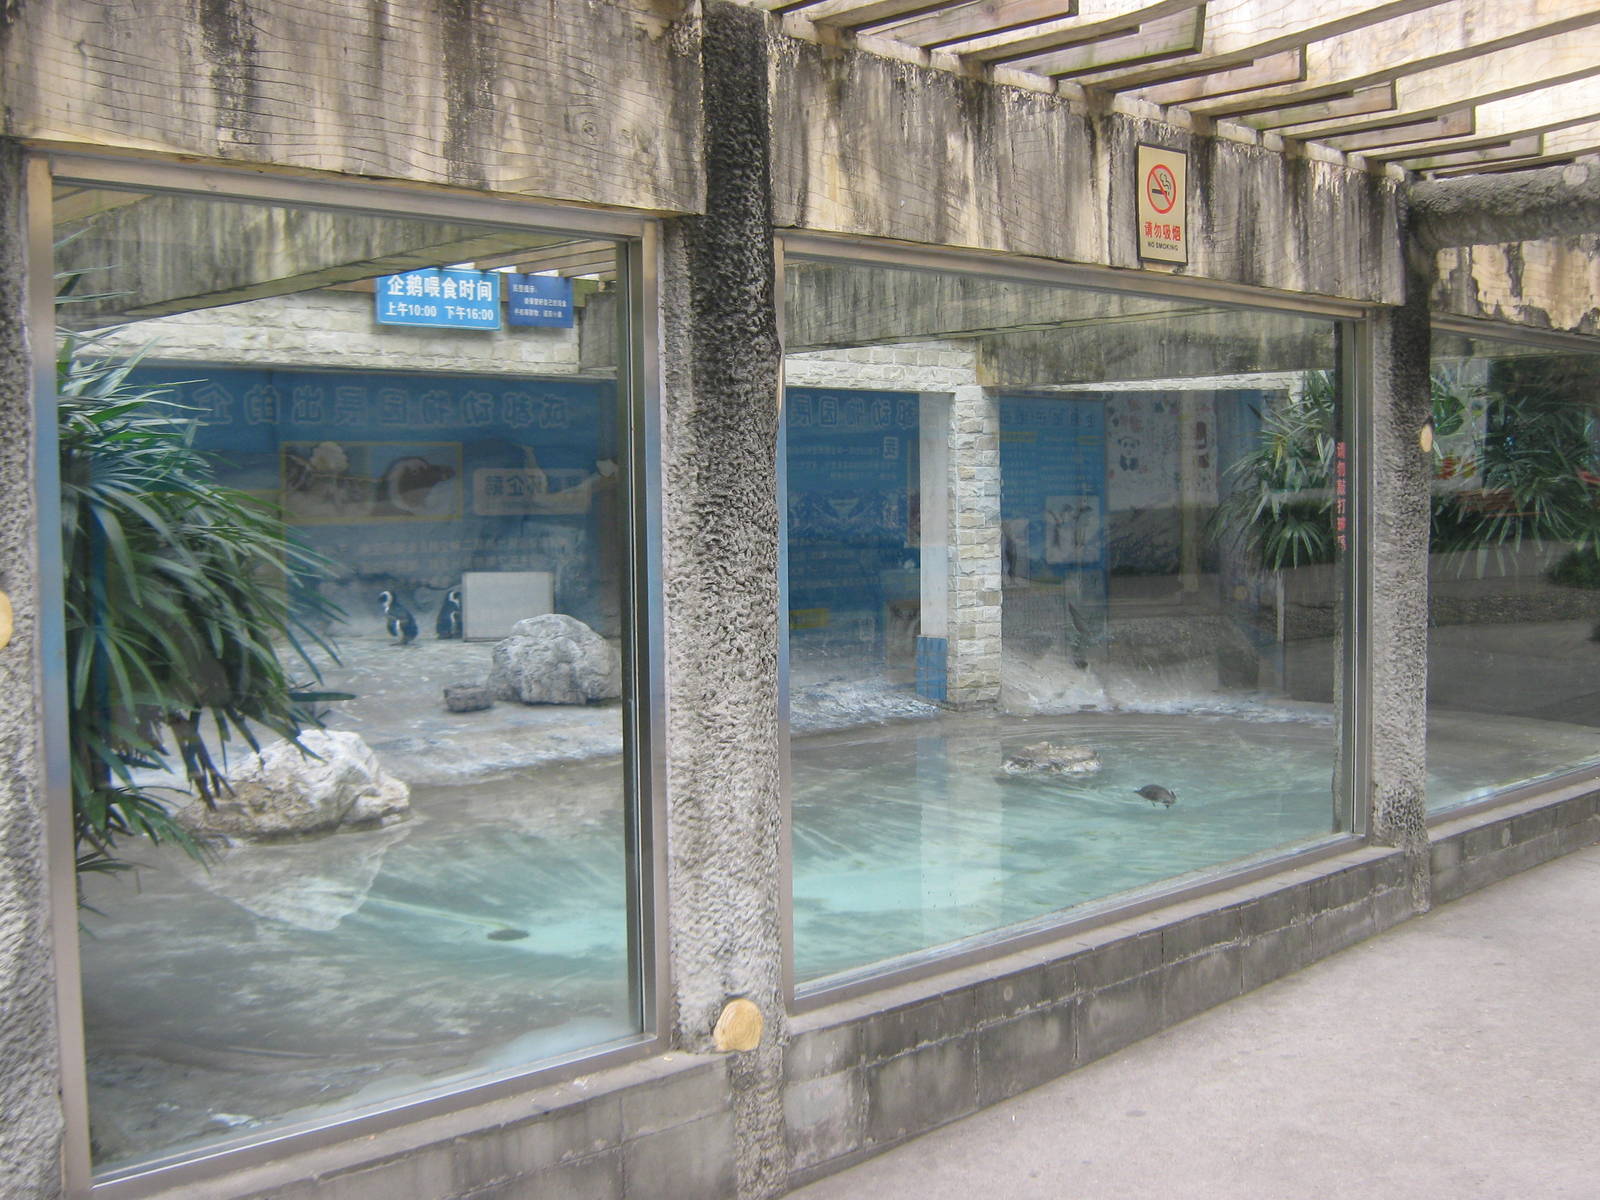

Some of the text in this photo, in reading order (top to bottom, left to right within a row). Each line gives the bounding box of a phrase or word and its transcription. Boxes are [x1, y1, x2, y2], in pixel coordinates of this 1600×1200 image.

[1144, 221, 1181, 241] 请勿吸烟
[1156, 242, 1178, 251] SMOKING
[387, 274, 493, 302] 企鹅喂食时间
[386, 302, 494, 321] 上午10:00 下午16:00
